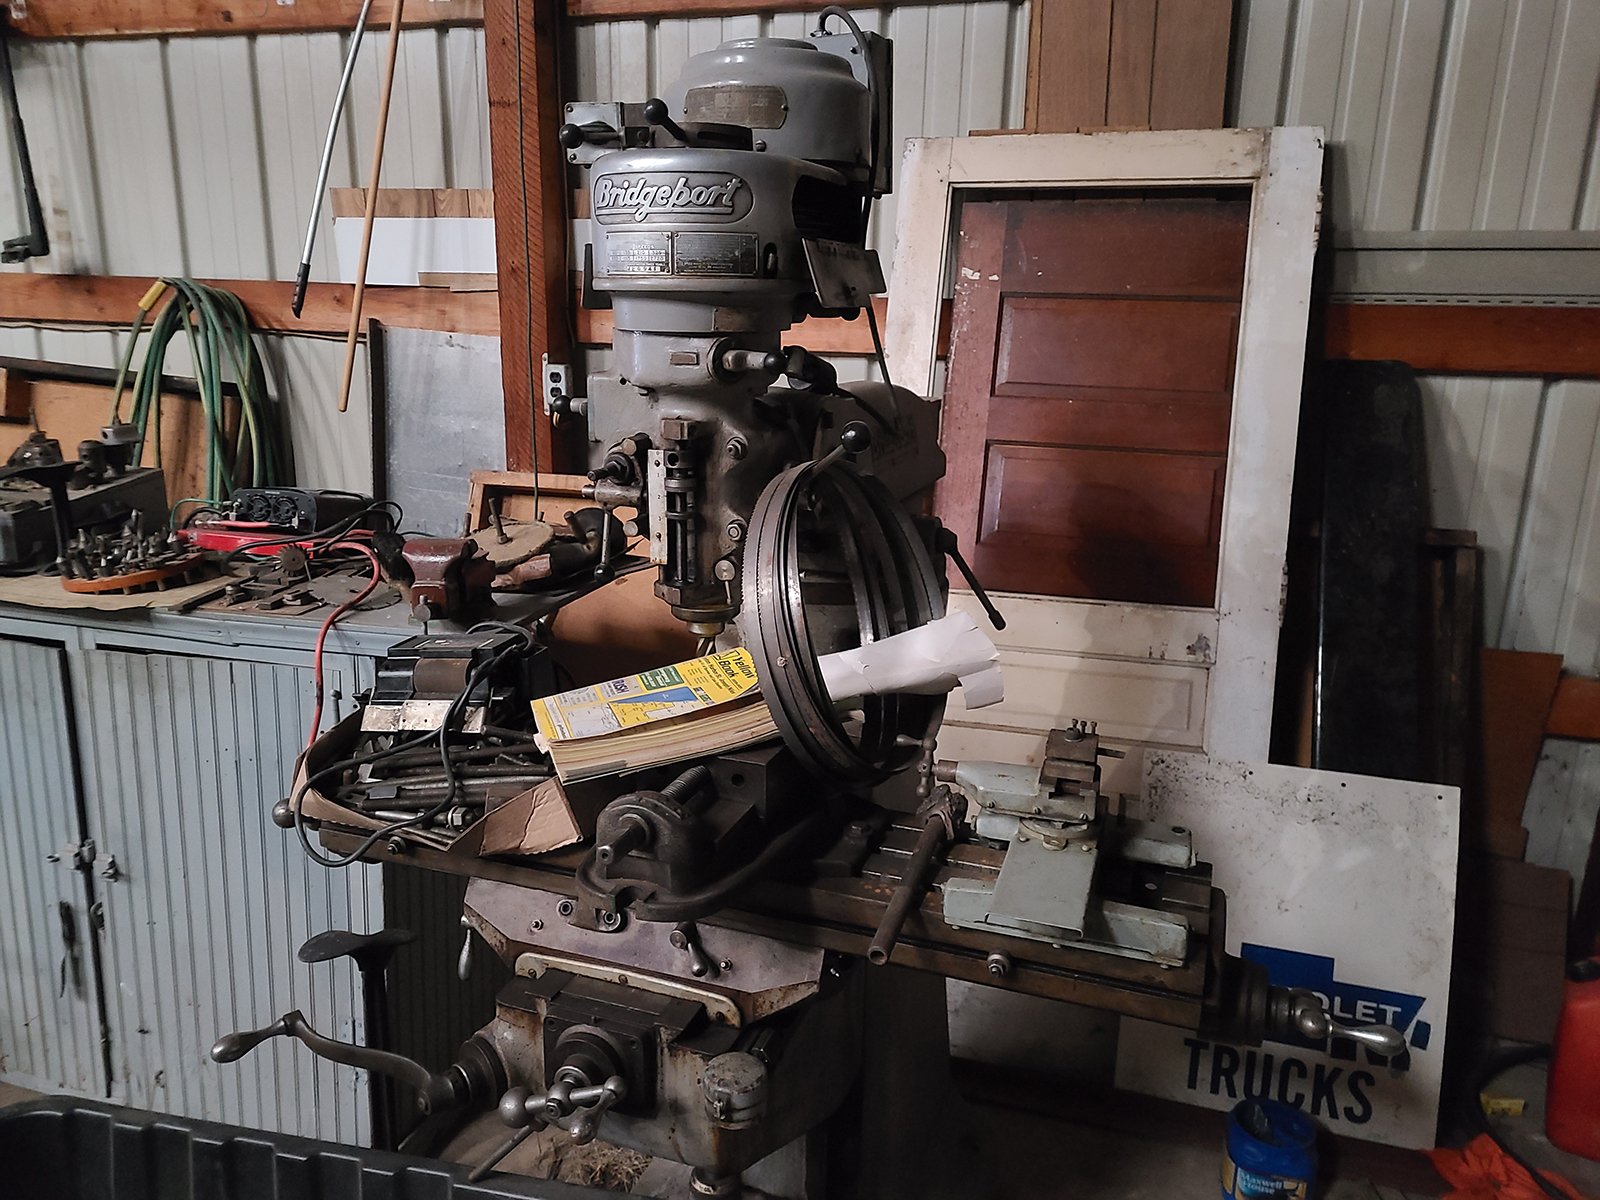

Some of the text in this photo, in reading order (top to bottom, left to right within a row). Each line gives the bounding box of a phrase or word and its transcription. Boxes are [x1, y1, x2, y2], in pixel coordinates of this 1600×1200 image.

[596, 176, 743, 223] Bridgeport
[718, 660, 739, 678] Book
[733, 656, 755, 678] Yellow
[1184, 1037, 1376, 1124] TRUCKS
[1240, 1173, 1283, 1190] Maxwell
[1242, 1180, 1276, 1194] House
